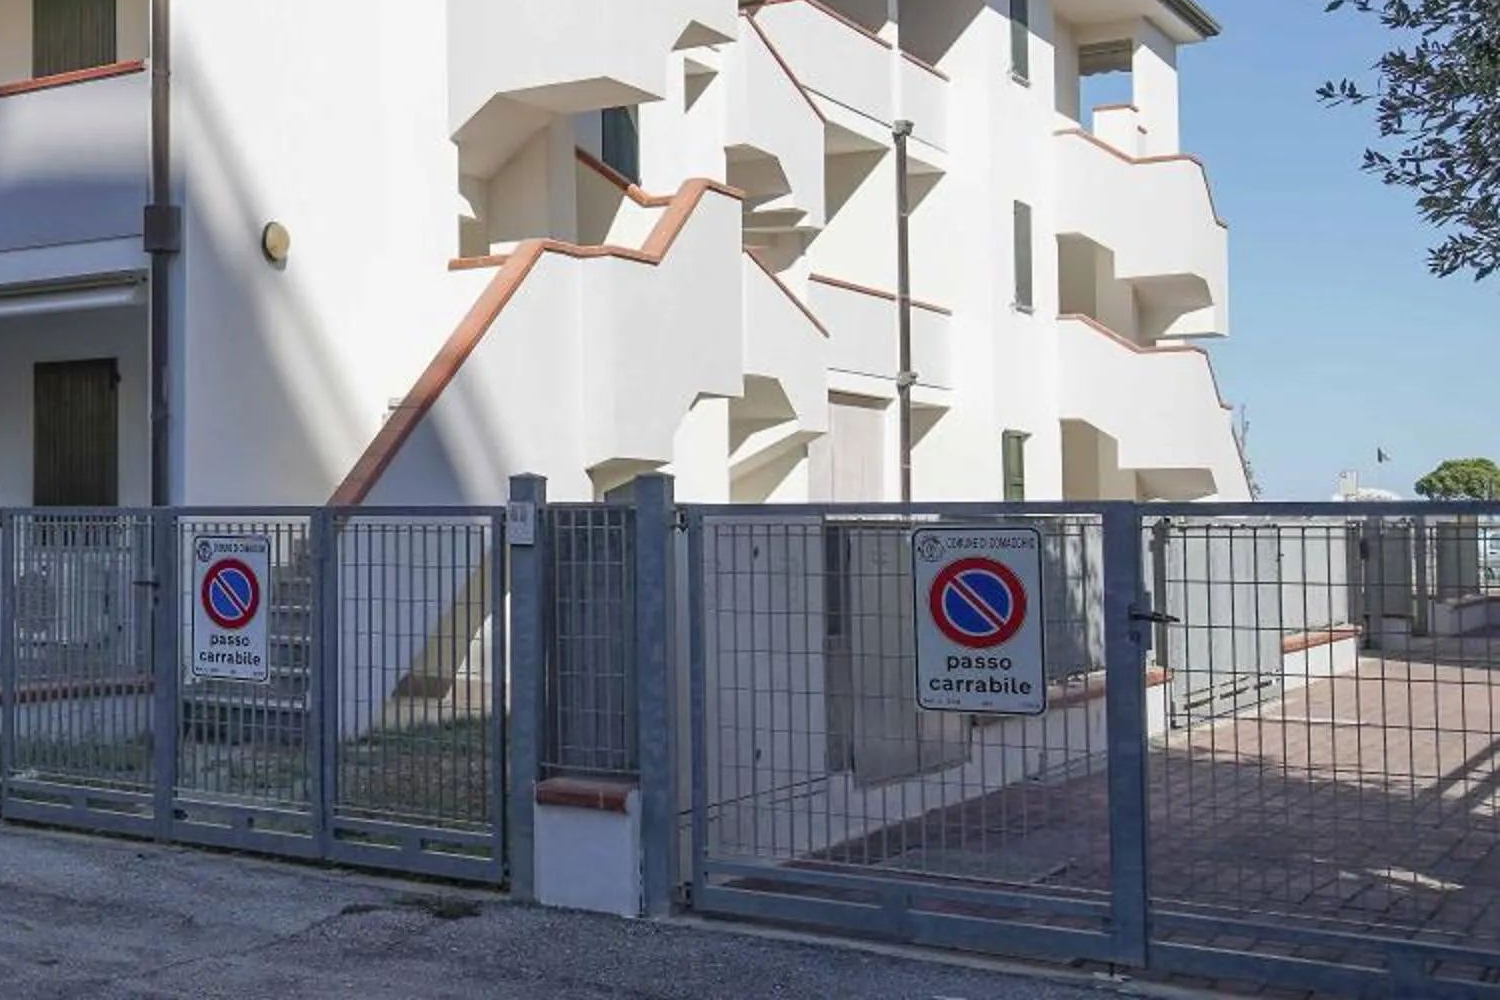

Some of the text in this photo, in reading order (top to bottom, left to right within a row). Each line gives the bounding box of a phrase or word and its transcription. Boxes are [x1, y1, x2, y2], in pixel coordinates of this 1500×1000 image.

[210, 633, 250, 647] passo
[199, 650, 261, 666] carrabile
[947, 655, 1012, 671] passo
[929, 677, 1032, 695] carrabile
